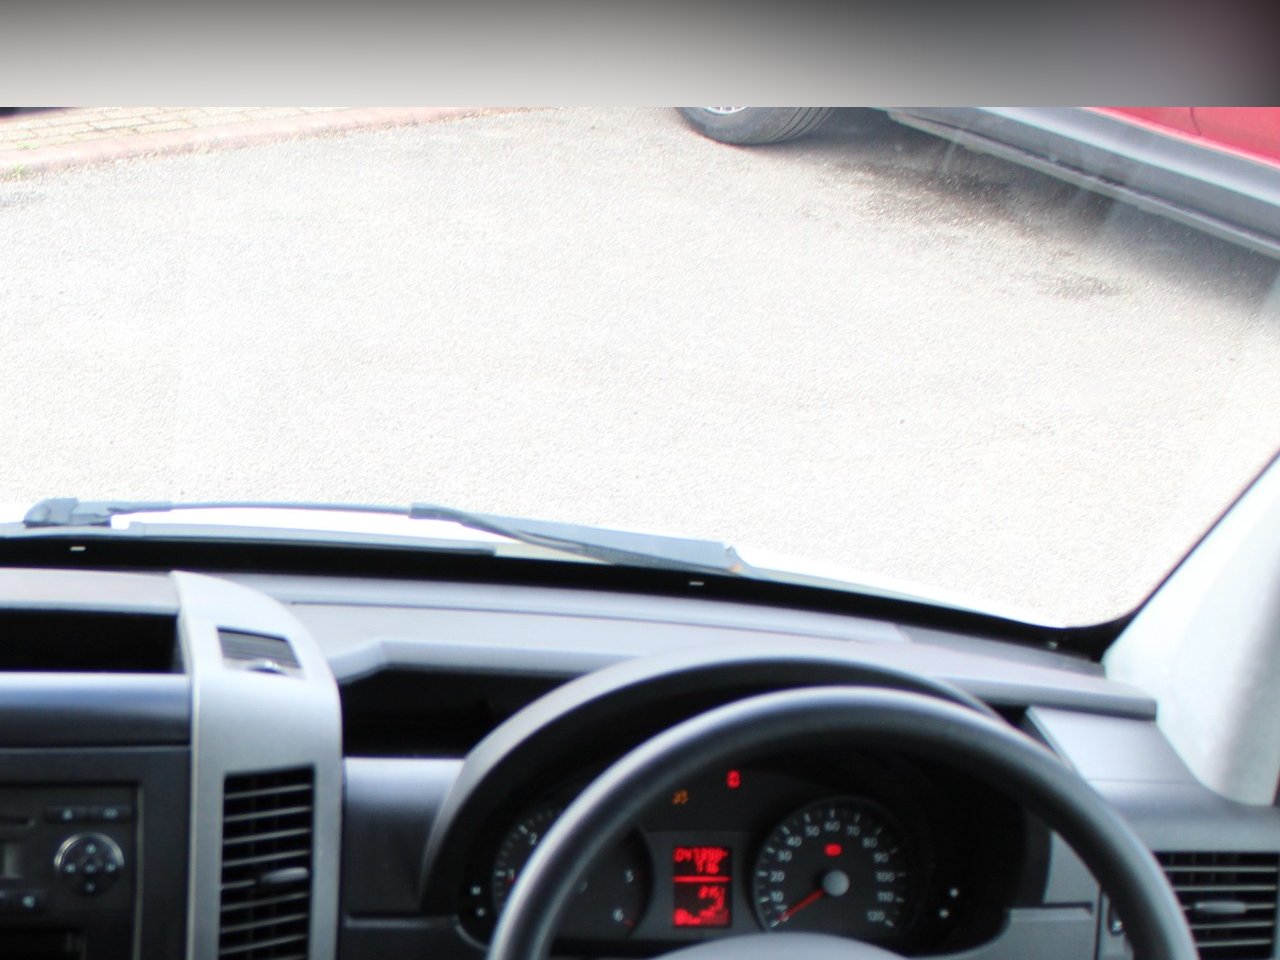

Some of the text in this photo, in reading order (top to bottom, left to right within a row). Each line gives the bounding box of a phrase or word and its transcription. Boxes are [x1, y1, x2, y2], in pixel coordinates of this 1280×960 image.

[805, 825, 820, 837] 50
[824, 821, 840, 832] 60
[847, 825, 860, 837] 70
[786, 836, 802, 847] 40
[862, 837, 878, 848] 80
[873, 852, 889, 863] 90
[770, 871, 785, 882] 20
[875, 871, 896, 882] 100
[771, 891, 784, 902] 10
[877, 891, 894, 902] 110
[612, 908, 624, 922] 6
[867, 910, 886, 922] 120
